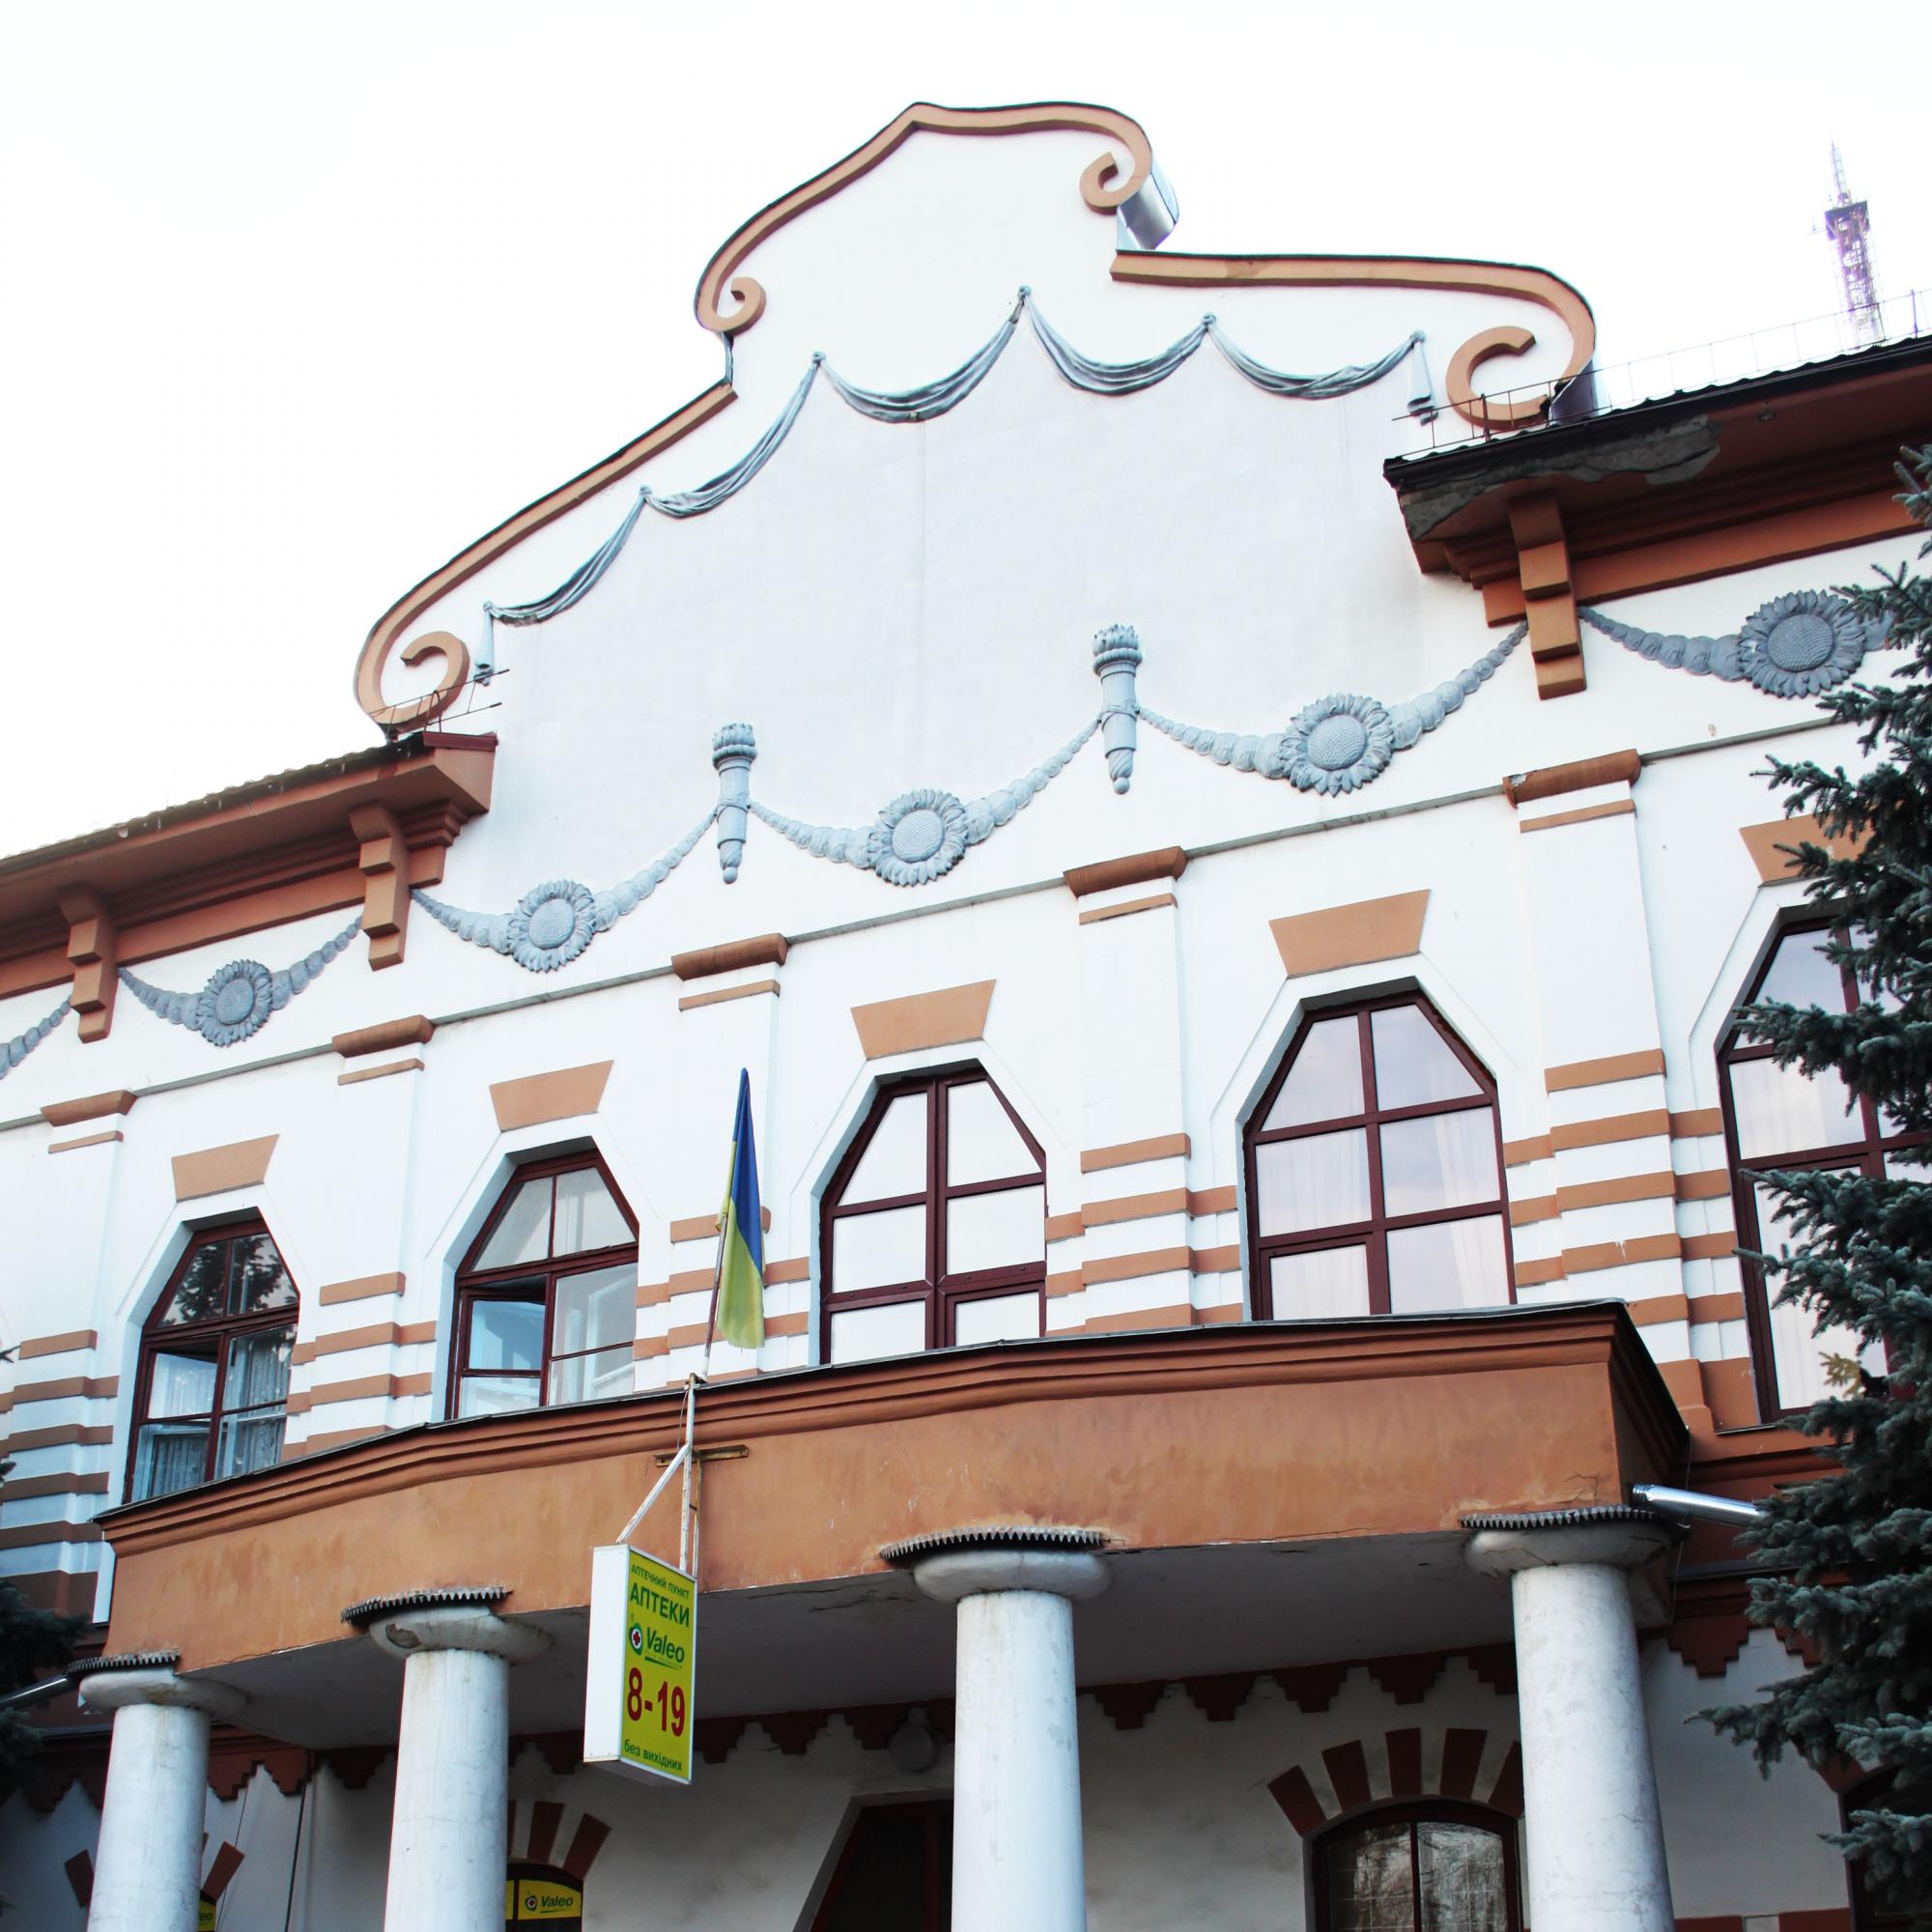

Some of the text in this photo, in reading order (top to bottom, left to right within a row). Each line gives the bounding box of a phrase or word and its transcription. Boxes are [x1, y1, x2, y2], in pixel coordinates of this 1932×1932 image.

[632, 1564, 690, 1600] АПТЕЧНИЙ ПУНКТ
[630, 1582, 690, 1627] АПТЕКИ
[646, 1627, 685, 1663] Valeo
[627, 1667, 685, 1737] 8-19
[624, 1739, 682, 1771] без вихідних
[541, 1895, 574, 1908] Valeo
